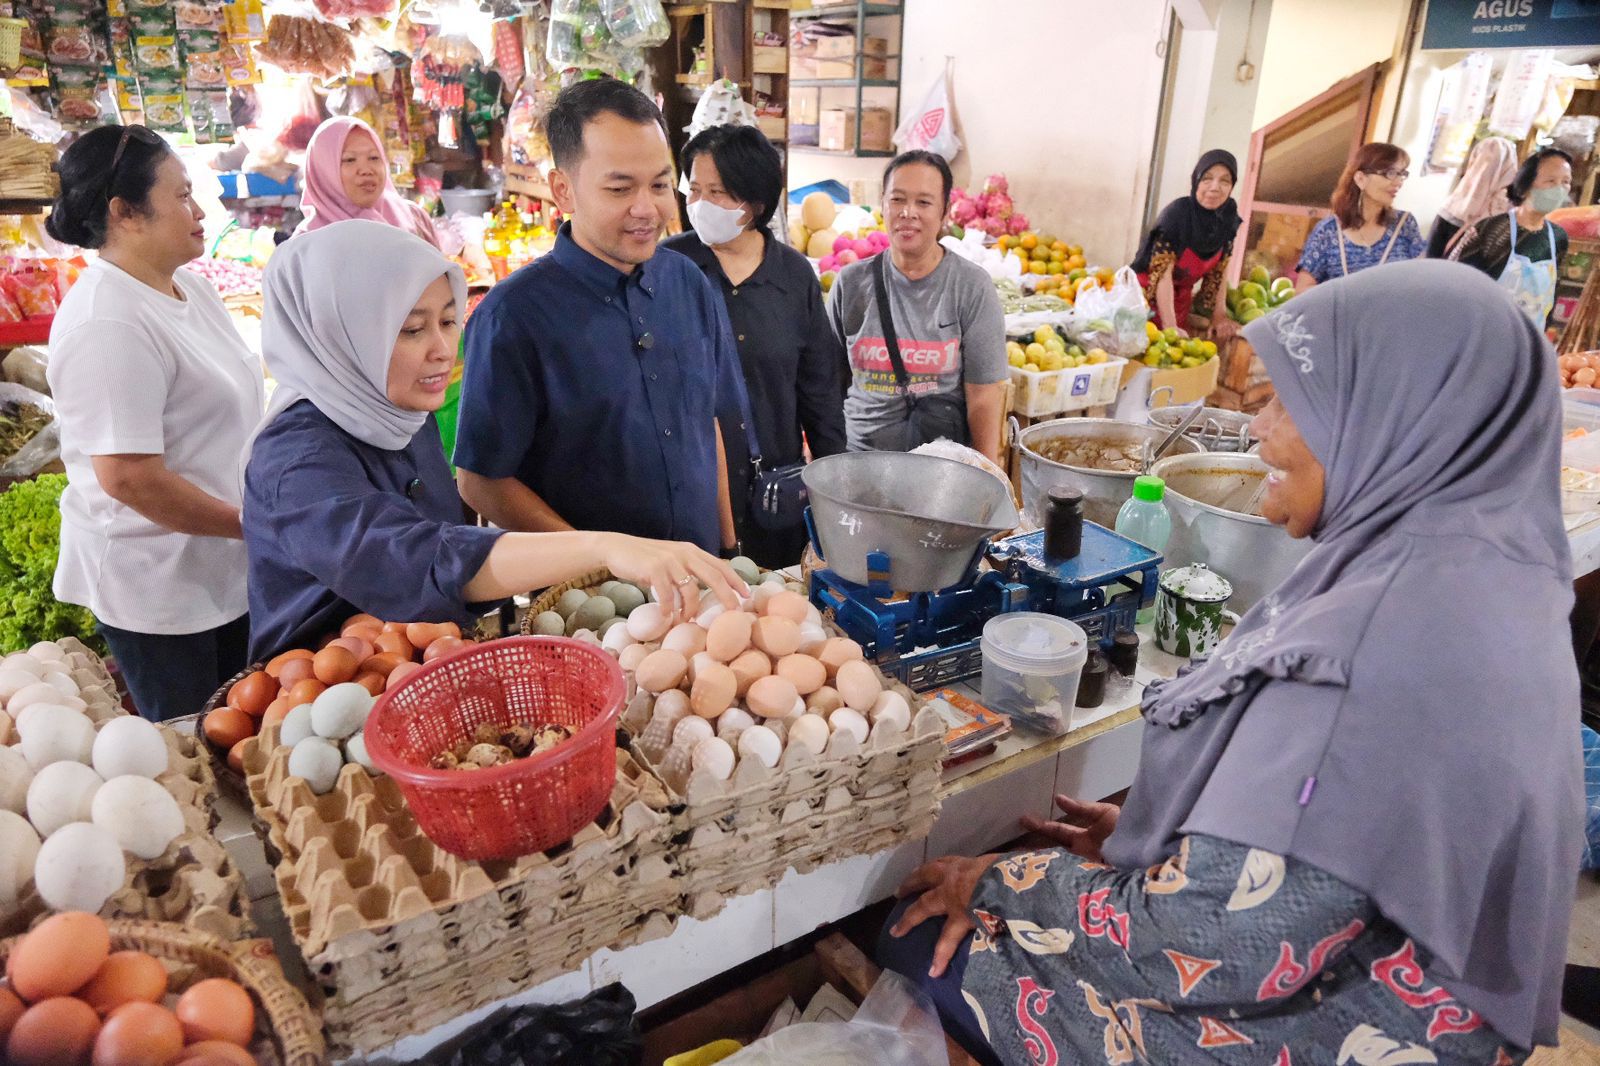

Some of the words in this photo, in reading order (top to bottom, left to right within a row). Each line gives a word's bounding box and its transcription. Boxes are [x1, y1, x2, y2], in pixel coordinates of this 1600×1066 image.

[1473, 0, 1532, 19] AGUS
[1492, 24, 1526, 32] PLASTIK
[859, 345, 940, 365] MOCER
